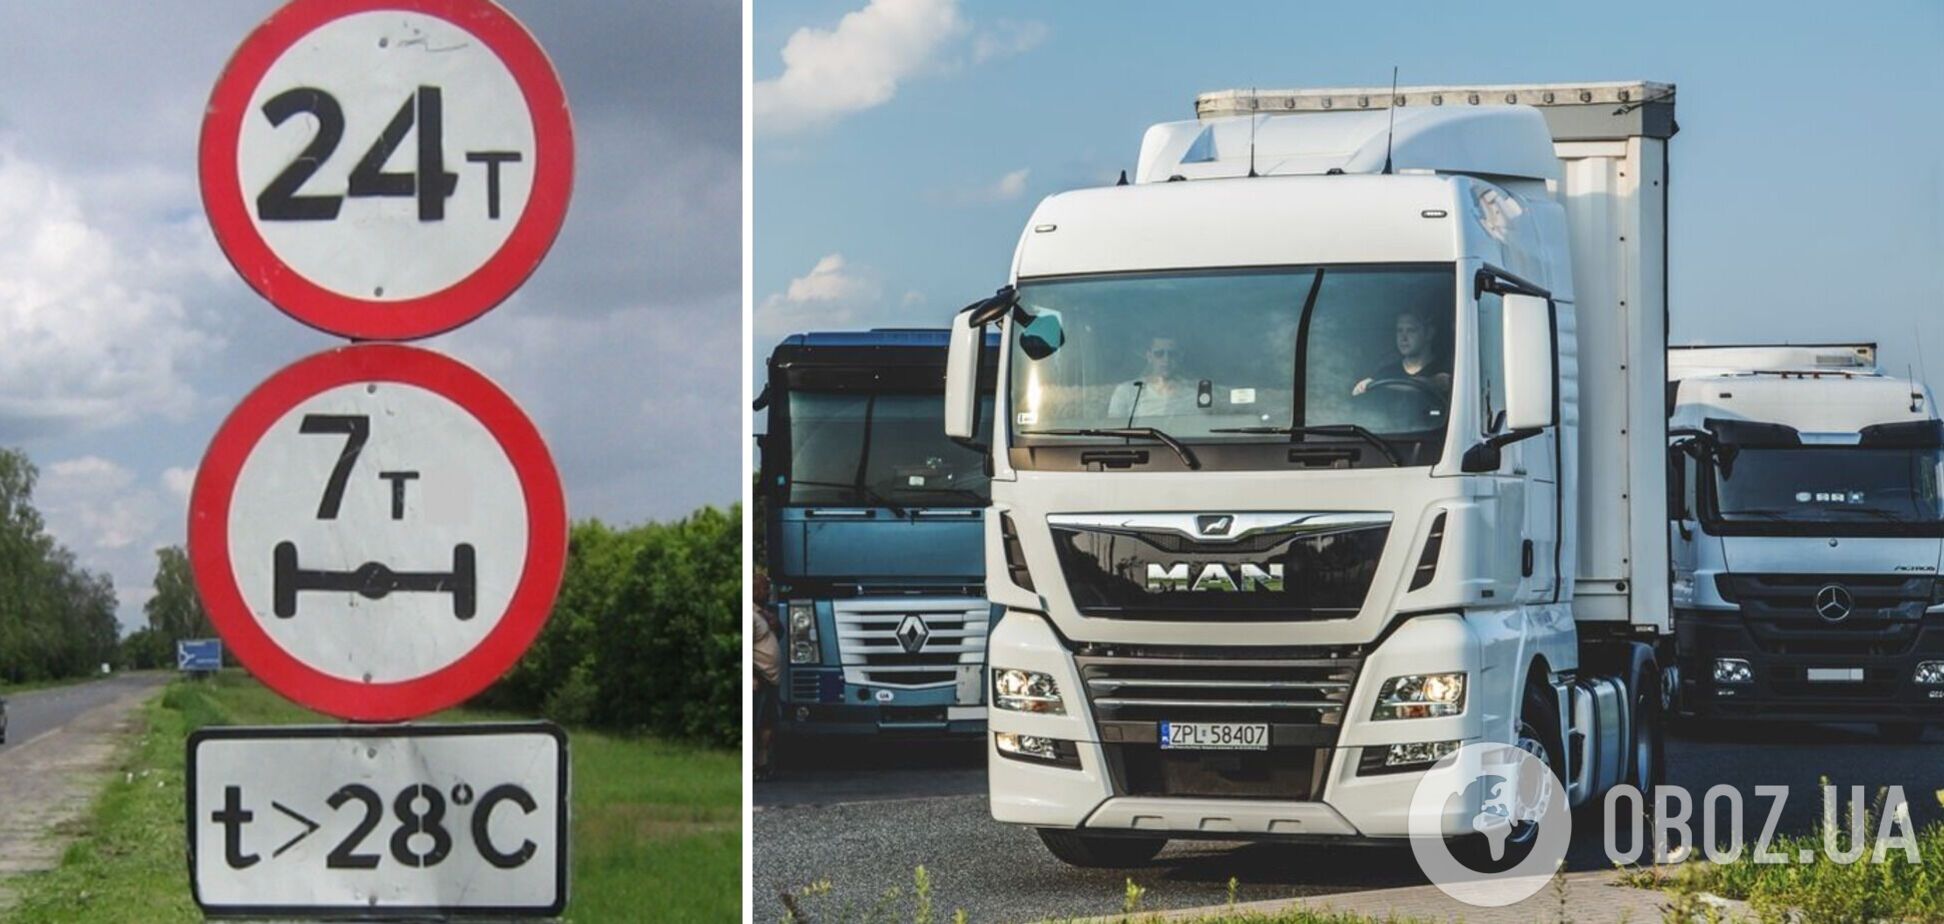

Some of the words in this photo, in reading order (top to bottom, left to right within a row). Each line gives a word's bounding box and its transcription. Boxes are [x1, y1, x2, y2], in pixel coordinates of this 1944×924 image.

[1147, 563, 1284, 592] MAN
[1171, 724, 1204, 744] ZPL
[1211, 725, 1266, 744] 58407
